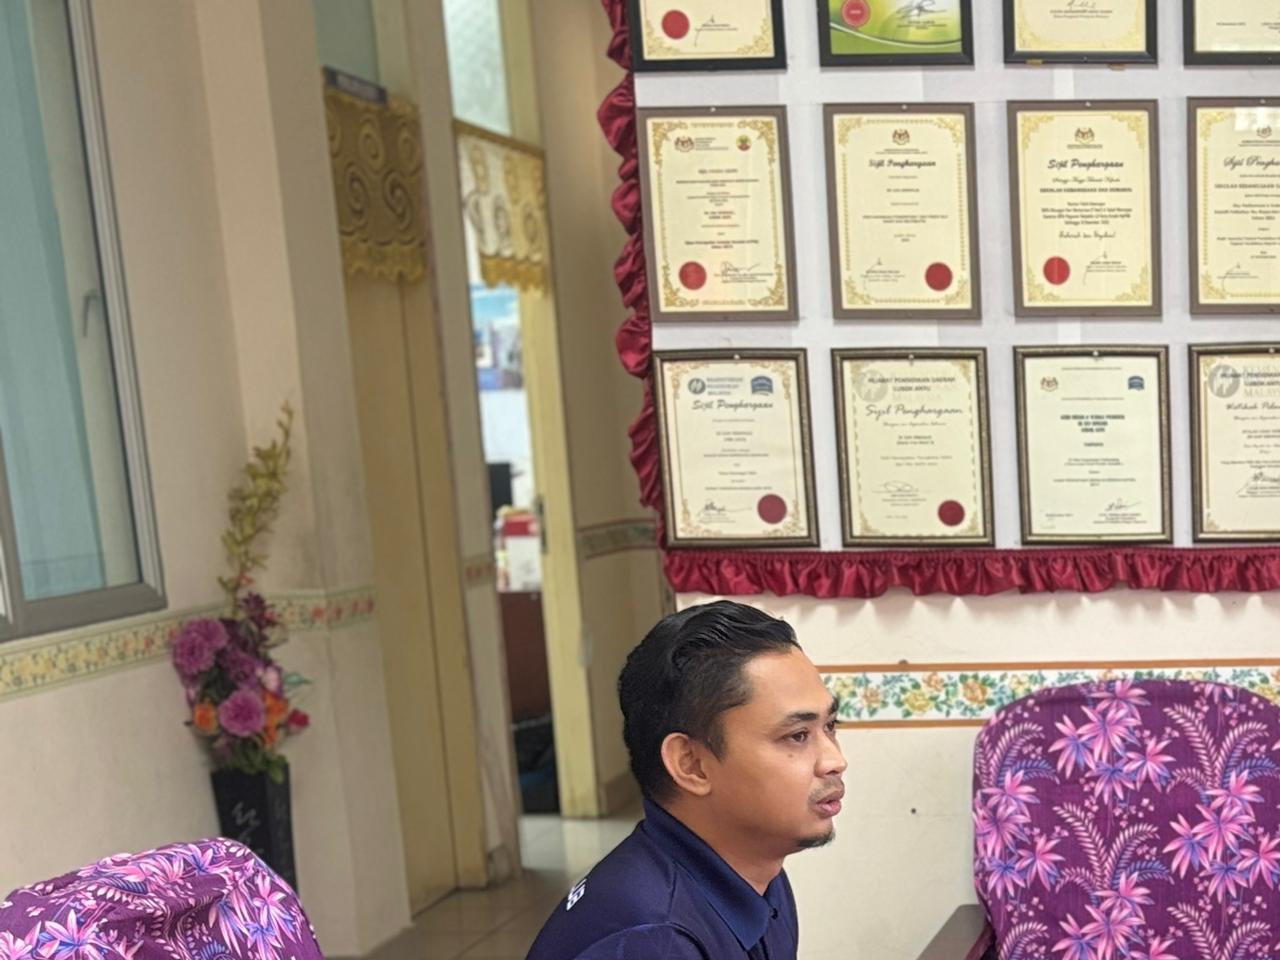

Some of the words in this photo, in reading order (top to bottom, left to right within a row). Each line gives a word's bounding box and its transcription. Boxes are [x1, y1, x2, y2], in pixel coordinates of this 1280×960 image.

[1070, 158, 1124, 172] Penghargaan
[717, 399, 773, 413] Penghargaan
[894, 403, 963, 419] Penghargaan
